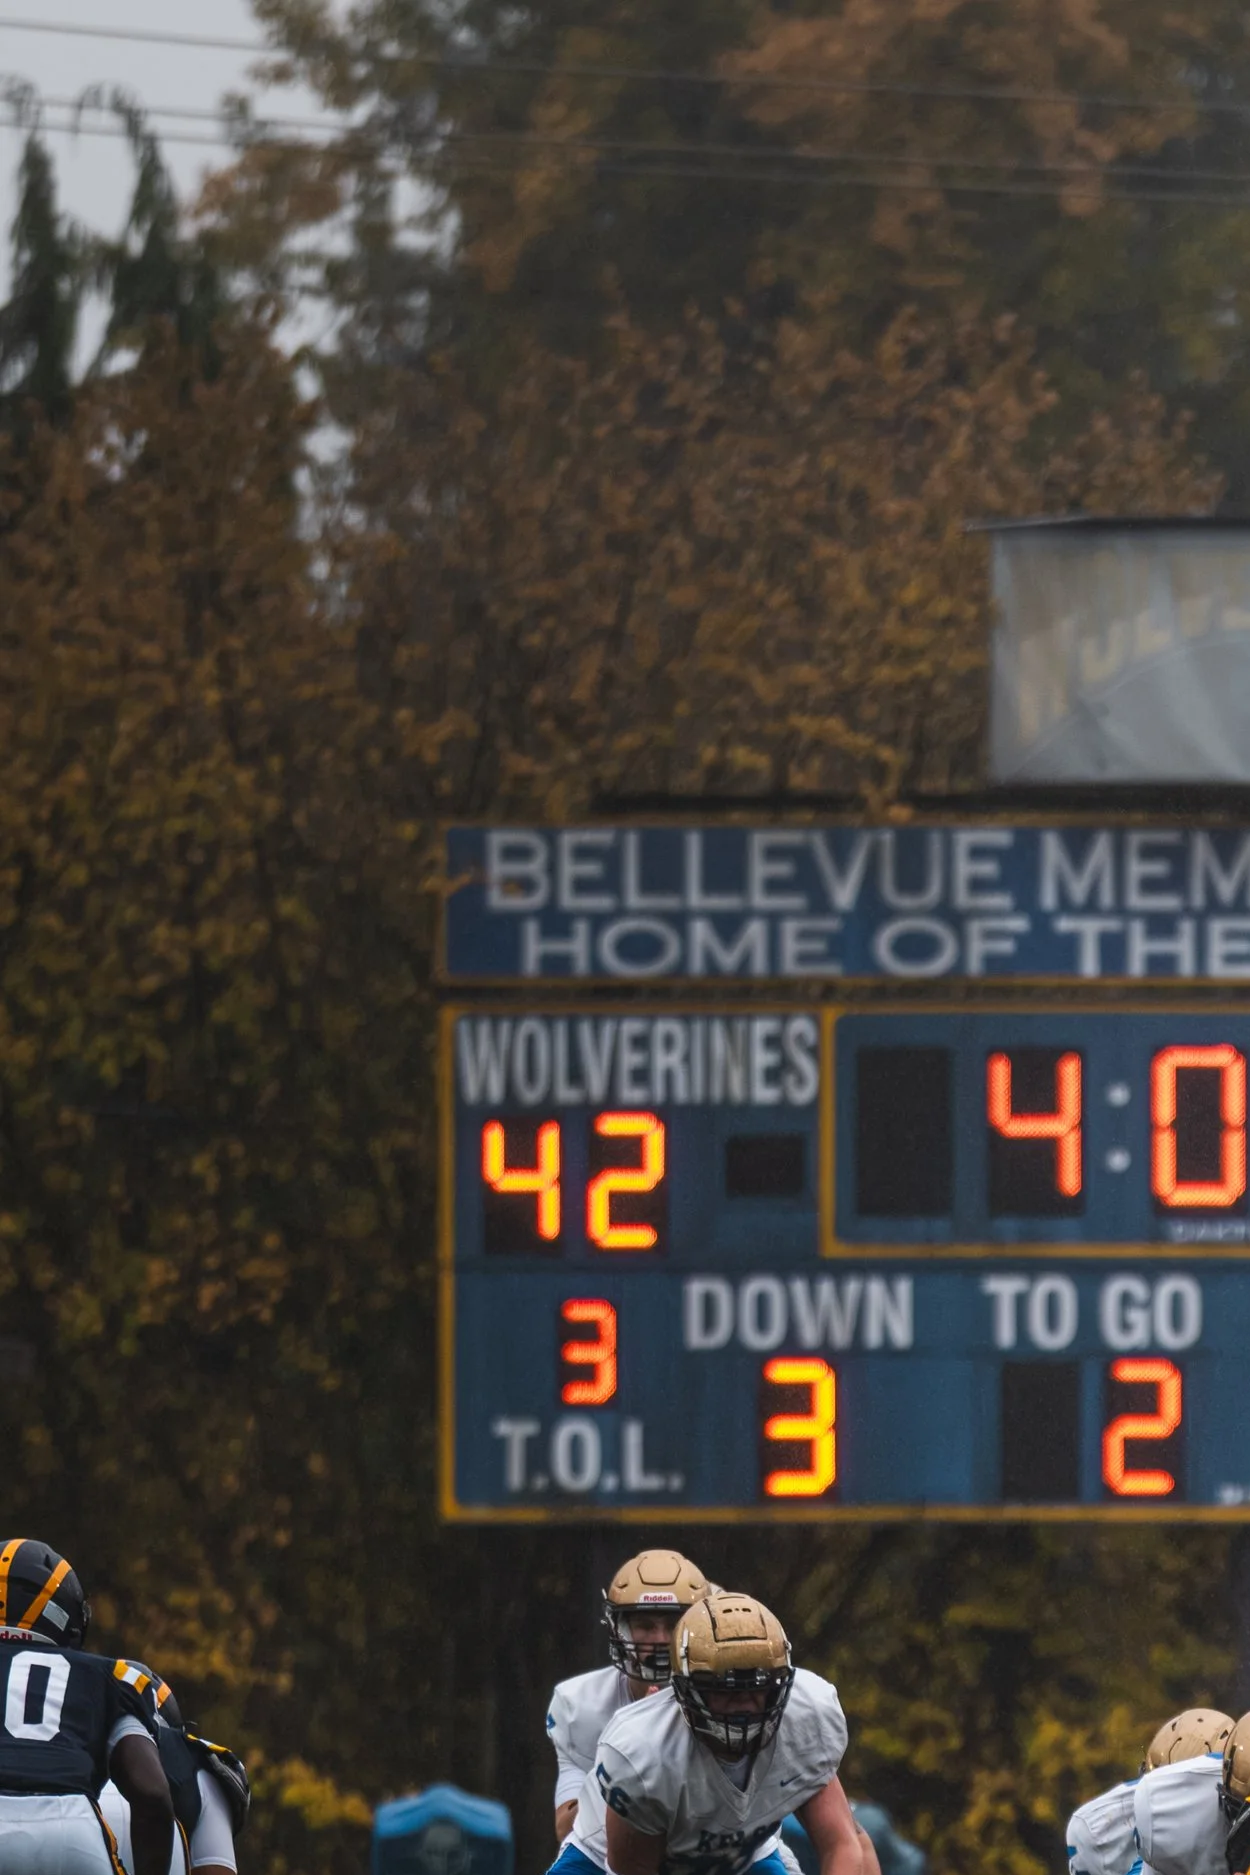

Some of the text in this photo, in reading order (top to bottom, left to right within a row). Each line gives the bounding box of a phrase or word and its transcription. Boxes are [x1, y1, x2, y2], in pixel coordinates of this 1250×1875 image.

[486, 830, 1015, 912] BELLEVUE
[522, 917, 844, 978] HOME
[875, 916, 1029, 979] OF
[457, 1016, 819, 1105] WOLVERINES
[482, 1111, 665, 1249] 42
[561, 1299, 617, 1405] 3
[685, 1277, 913, 1349] DOWN
[982, 1273, 1201, 1350] TO GO
[494, 1418, 684, 1491] T.O.L.
[764, 1357, 837, 1497] 3
[1102, 1357, 1182, 1496] 2
